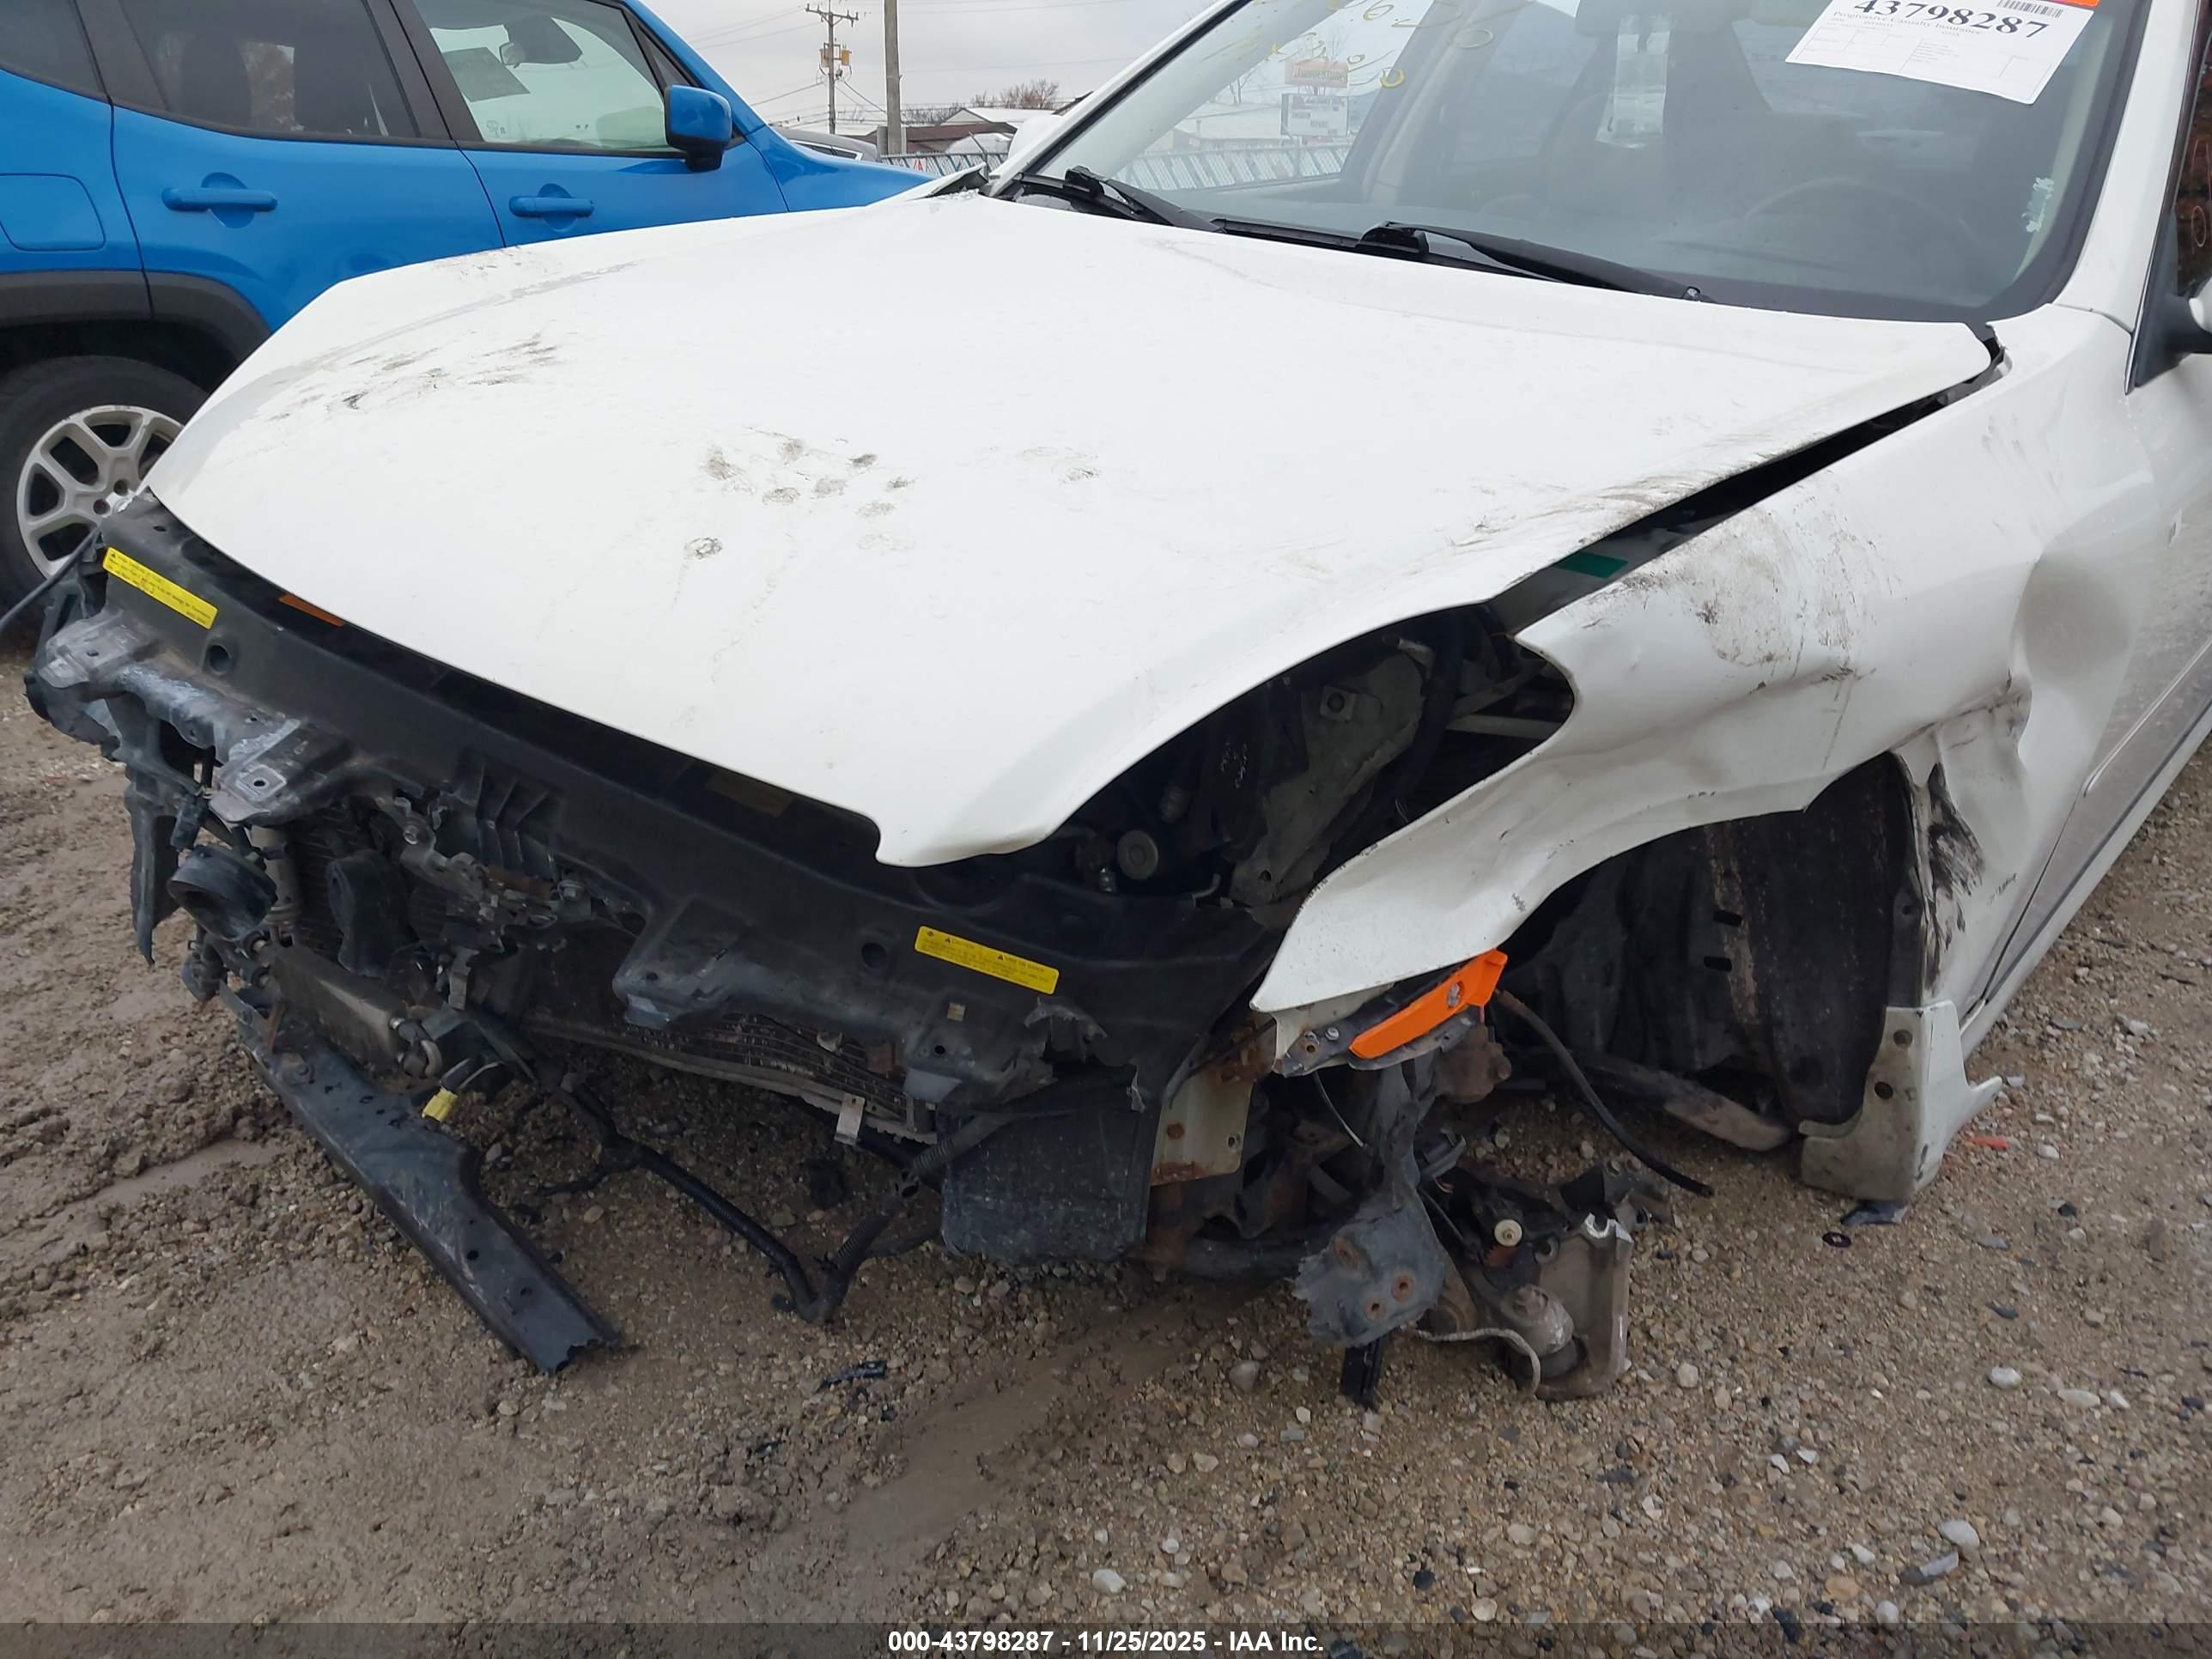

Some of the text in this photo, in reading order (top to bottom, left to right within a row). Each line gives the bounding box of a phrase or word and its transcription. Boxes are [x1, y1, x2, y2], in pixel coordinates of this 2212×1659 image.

[1833, 10, 1888, 23] Progressive
[1890, 16, 1930, 27] Casualty
[1935, 22, 1983, 35] Insurance
[1854, 0, 2050, 39] 43798287
